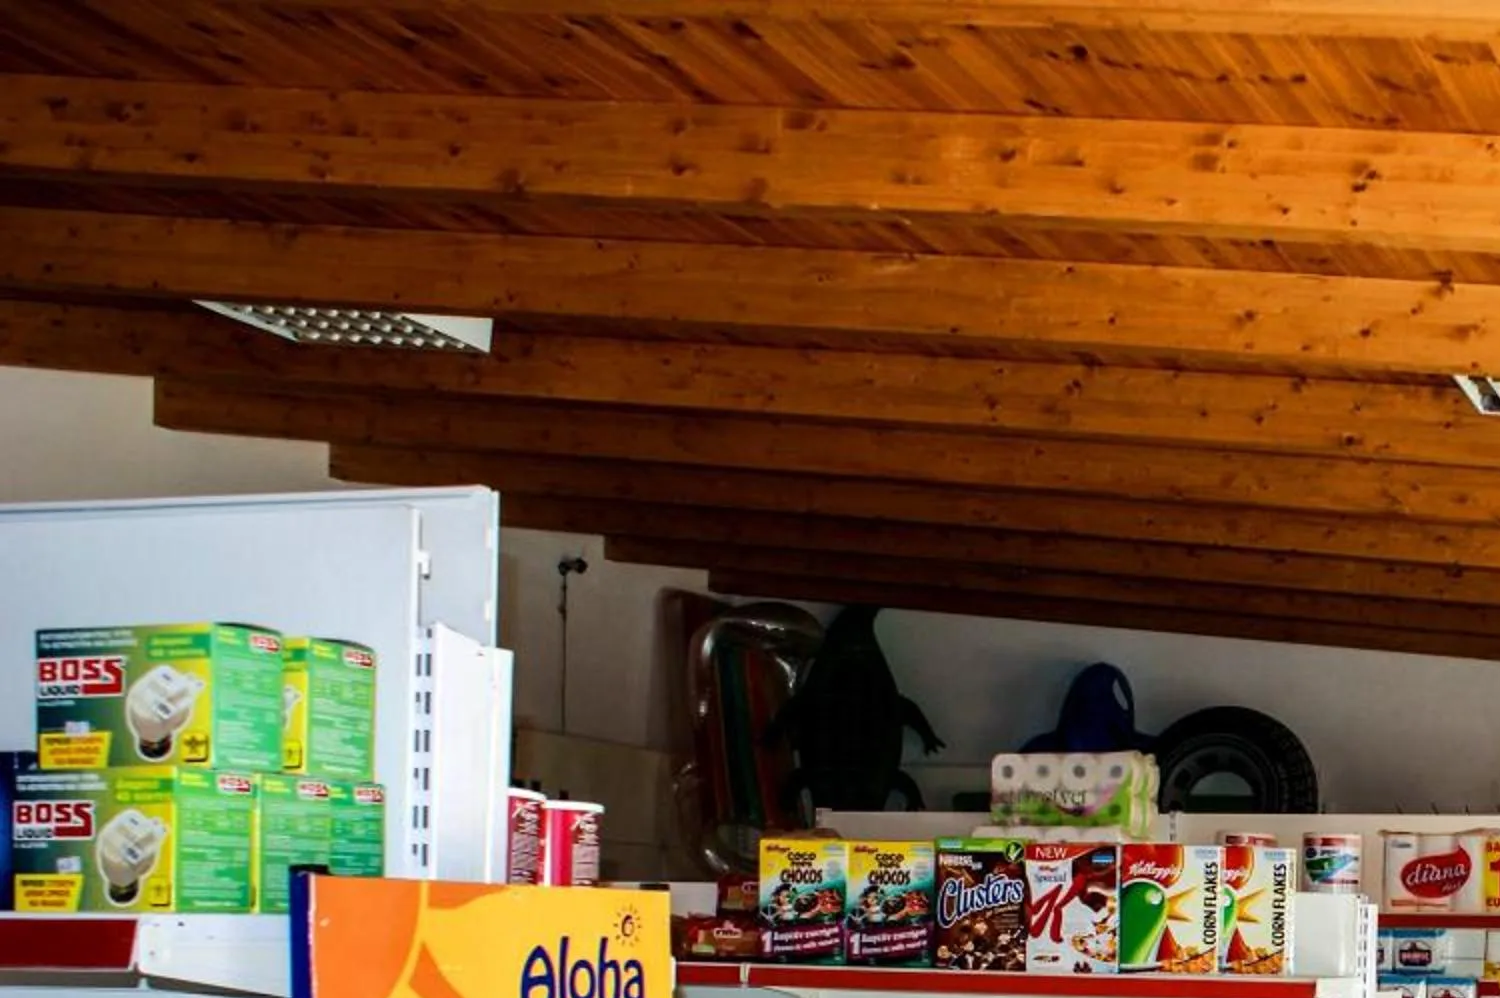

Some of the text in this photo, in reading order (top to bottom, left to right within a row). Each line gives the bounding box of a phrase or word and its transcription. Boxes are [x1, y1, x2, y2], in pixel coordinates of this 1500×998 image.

[38, 658, 124, 694] BOSS
[16, 803, 92, 837] BOSS
[1035, 846, 1067, 859] NEW
[781, 869, 823, 884] CHOCOS
[868, 870, 911, 885] CHOCOS
[1128, 860, 1182, 879] Kellogg's
[1406, 862, 1467, 886] diana
[937, 873, 1025, 929] Clusters
[1203, 861, 1219, 945] CORN FLAKES
[1272, 863, 1287, 947] CORN FLAKES
